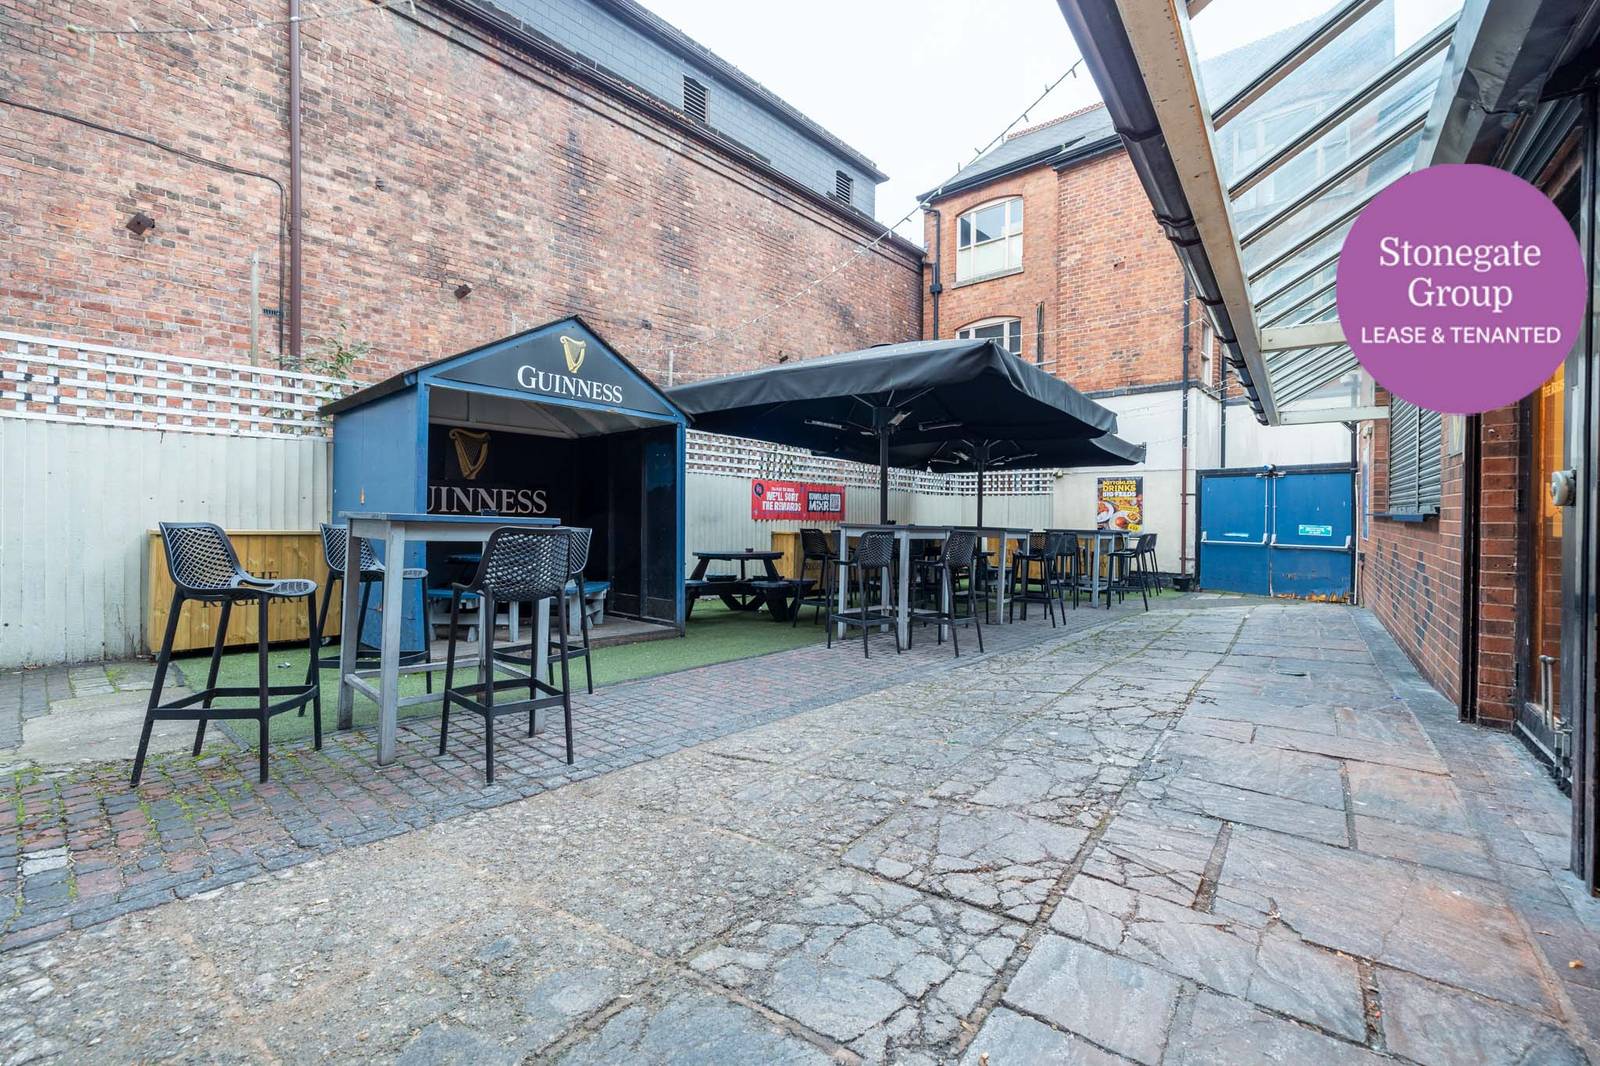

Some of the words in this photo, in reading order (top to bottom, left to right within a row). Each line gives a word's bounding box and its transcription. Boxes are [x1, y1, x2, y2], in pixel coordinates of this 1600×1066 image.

[517, 365, 623, 403] GUINNESS
[427, 485, 548, 514] INNESS
[762, 501, 774, 510] THE
[774, 501, 802, 512] REWARDS
